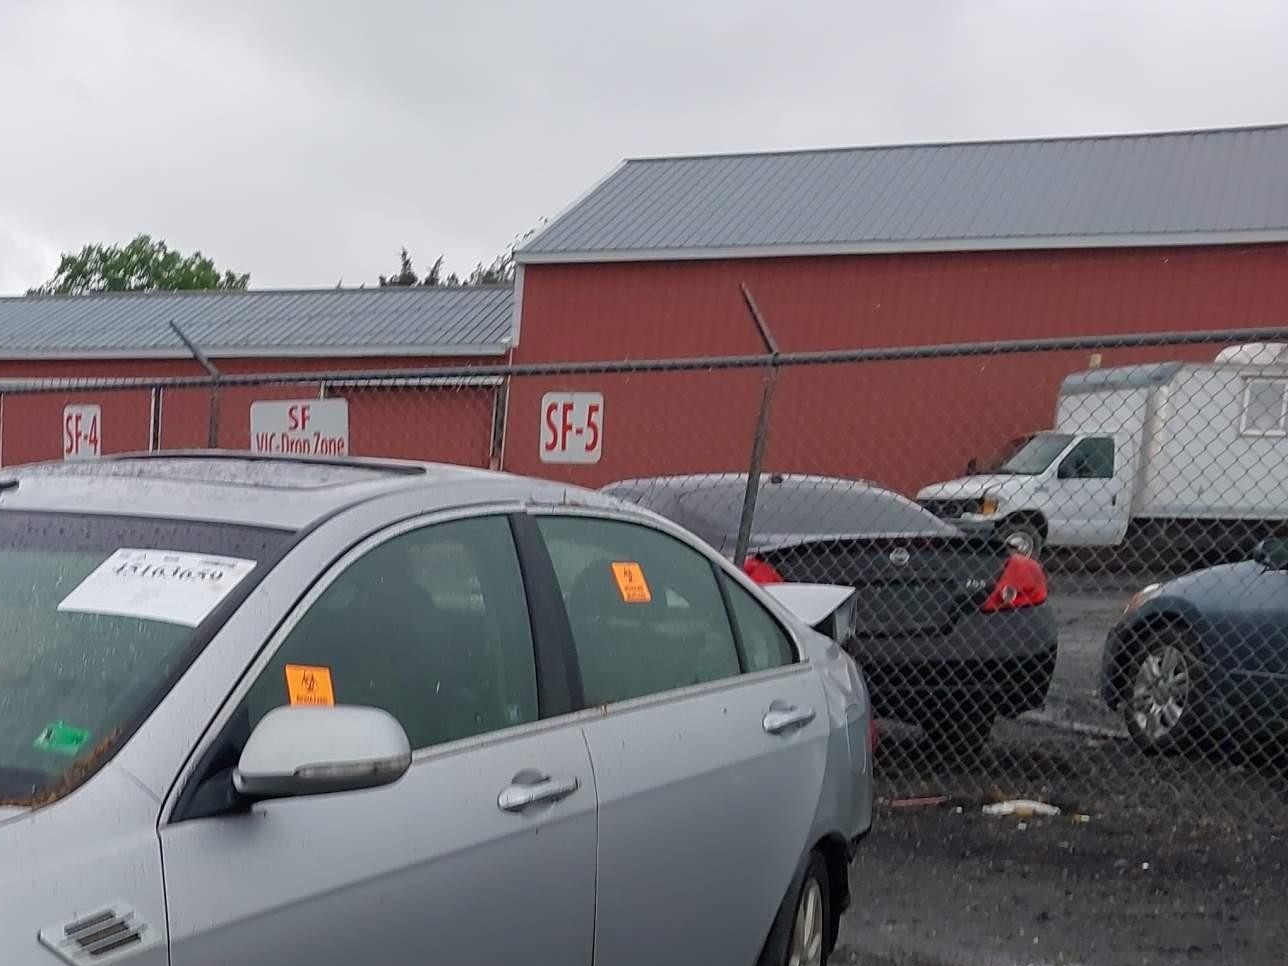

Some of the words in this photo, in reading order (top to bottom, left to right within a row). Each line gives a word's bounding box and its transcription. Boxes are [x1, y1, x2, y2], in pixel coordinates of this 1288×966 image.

[65, 413, 98, 456] SF-4
[288, 404, 311, 431] SF
[544, 402, 600, 452] SF-5
[313, 430, 345, 457] Zone
